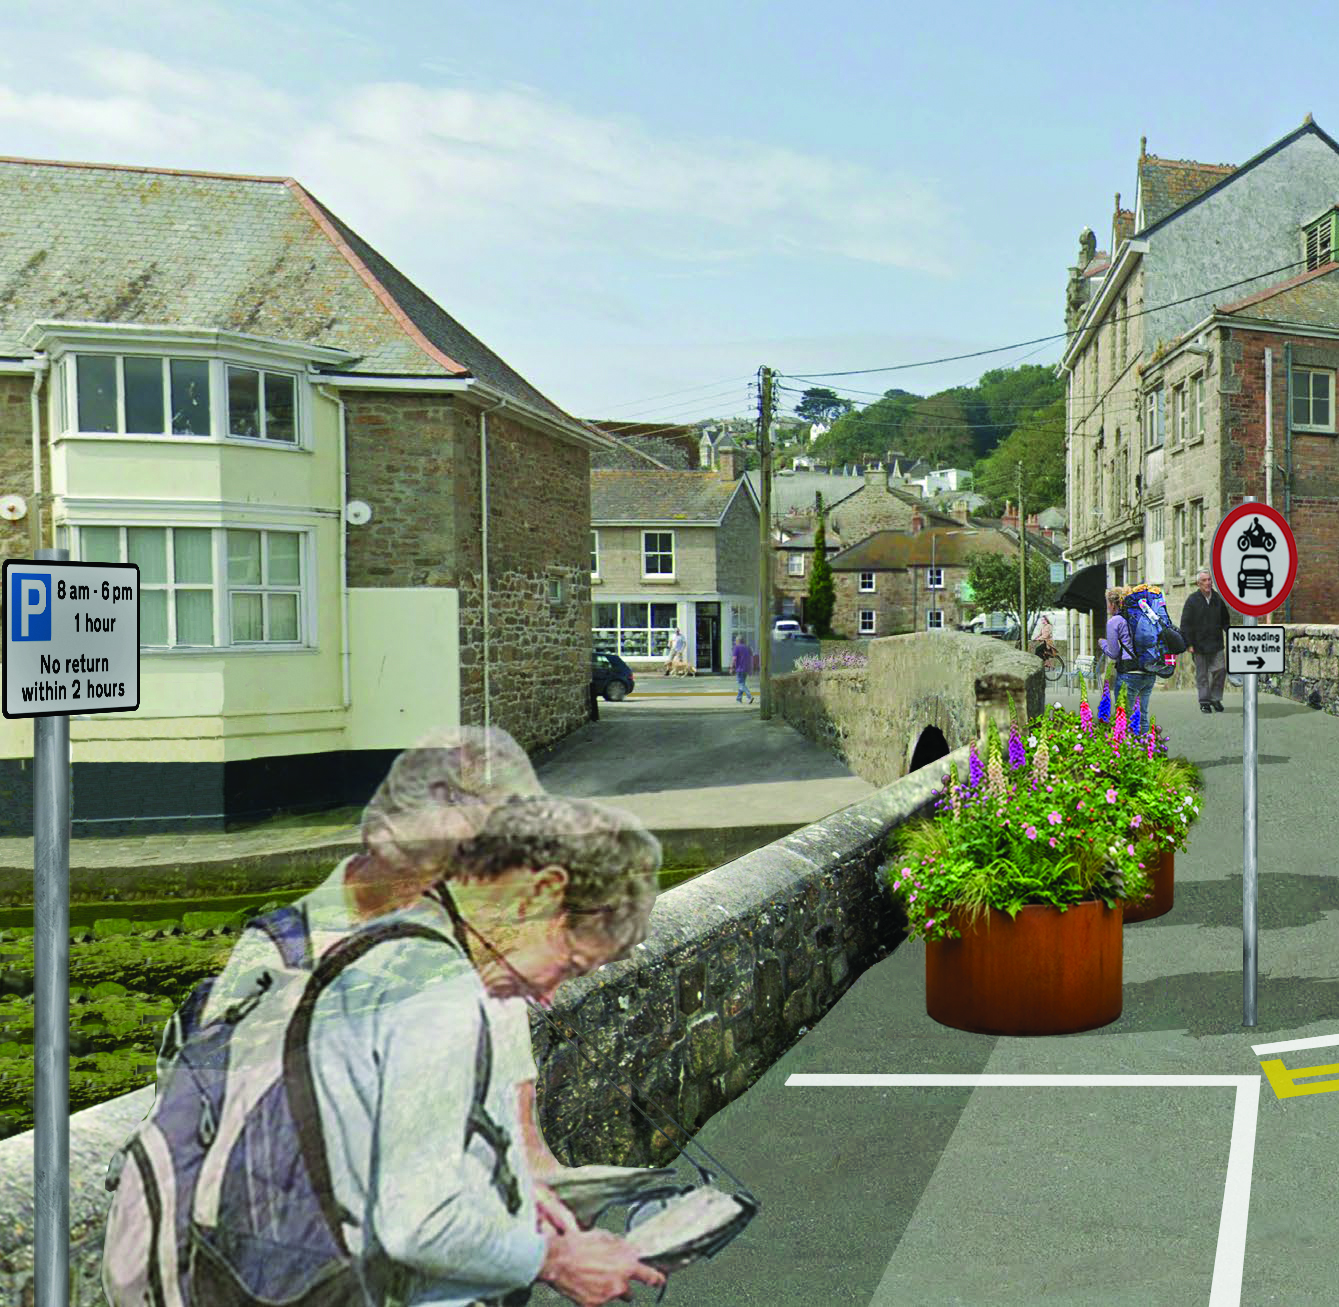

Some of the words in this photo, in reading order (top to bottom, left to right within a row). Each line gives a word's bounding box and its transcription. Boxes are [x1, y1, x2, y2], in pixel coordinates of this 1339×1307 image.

[21, 579, 47, 637] P
[74, 612, 80, 632] 1
[85, 612, 116, 632] hour
[1232, 632, 1245, 641] No
[1247, 631, 1280, 643] loading
[1231, 644, 1241, 653] at
[1243, 645, 1260, 654] any
[1261, 643, 1281, 653] time
[40, 654, 61, 674] No
[65, 654, 109, 673] return
[21, 680, 67, 702] within
[71, 679, 81, 699] 2
[87, 679, 125, 698] hours
